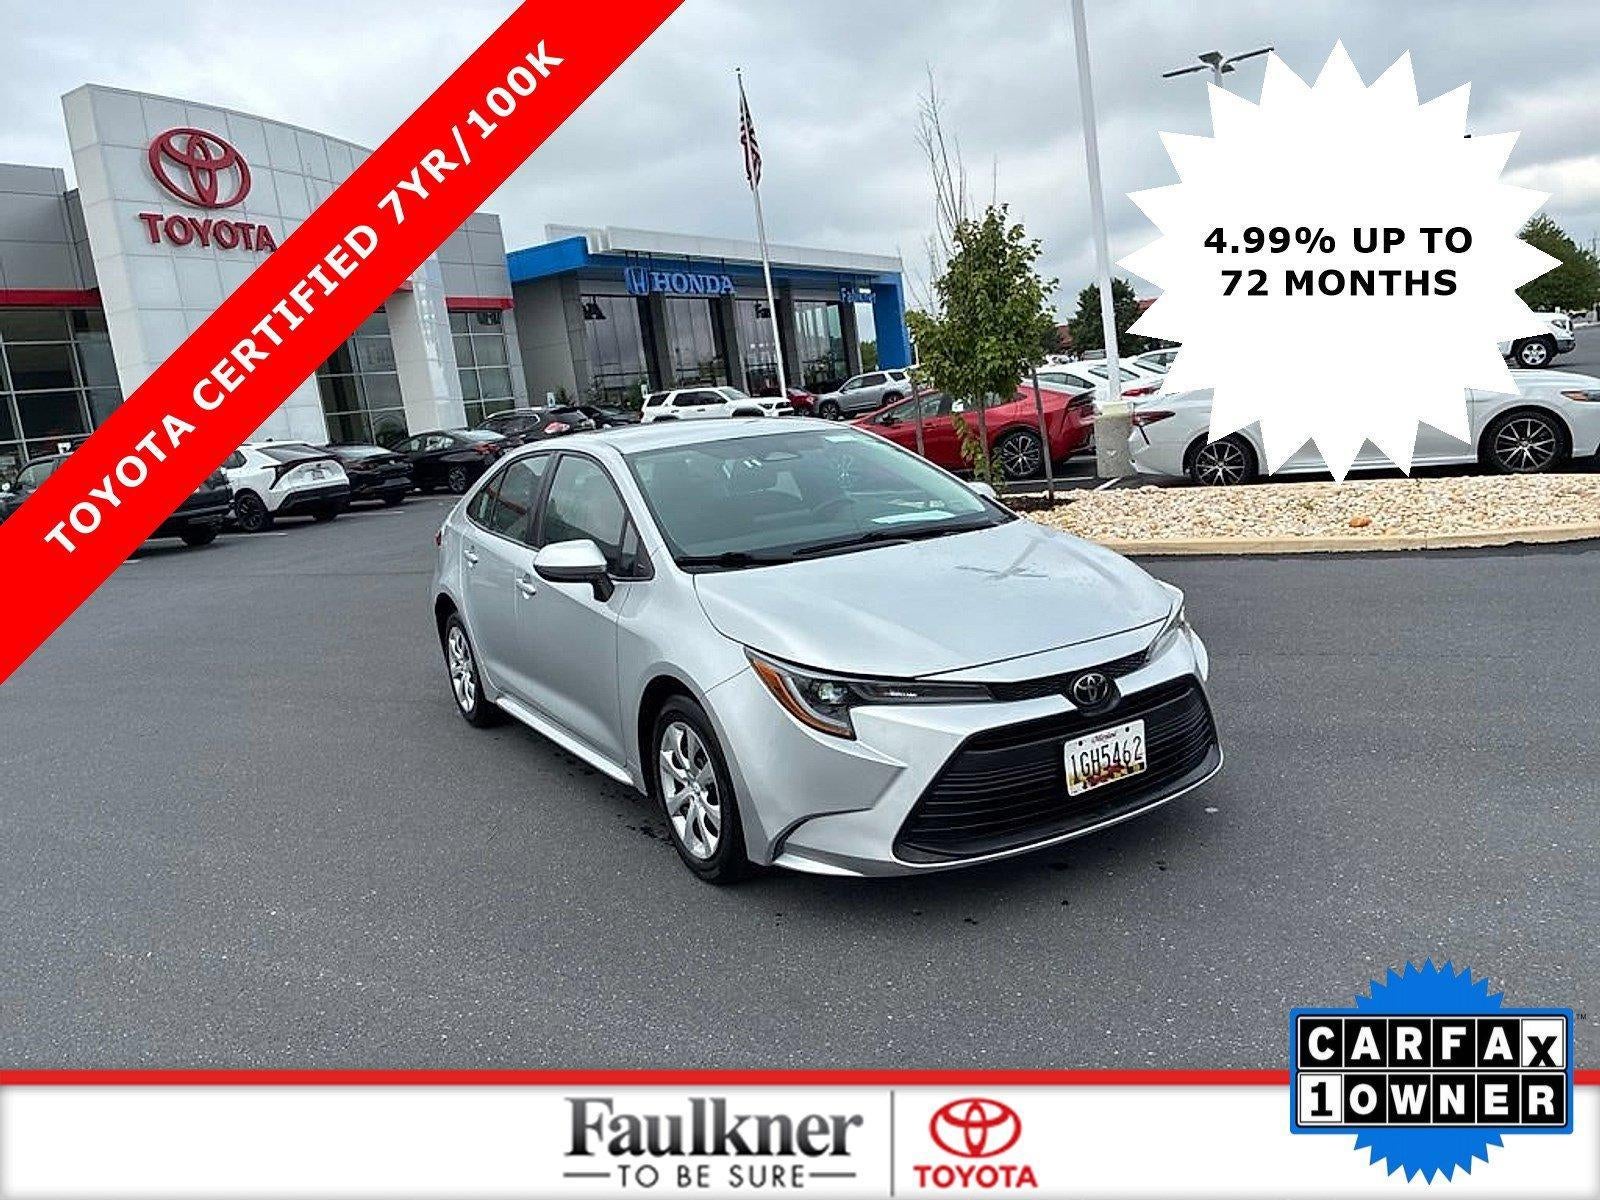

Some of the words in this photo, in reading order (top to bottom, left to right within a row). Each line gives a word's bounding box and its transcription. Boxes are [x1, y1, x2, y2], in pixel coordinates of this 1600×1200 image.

[139, 212, 277, 252] TOYOTA
[651, 271, 735, 295] HONDA
[1070, 735, 1144, 786] 1GH5462
